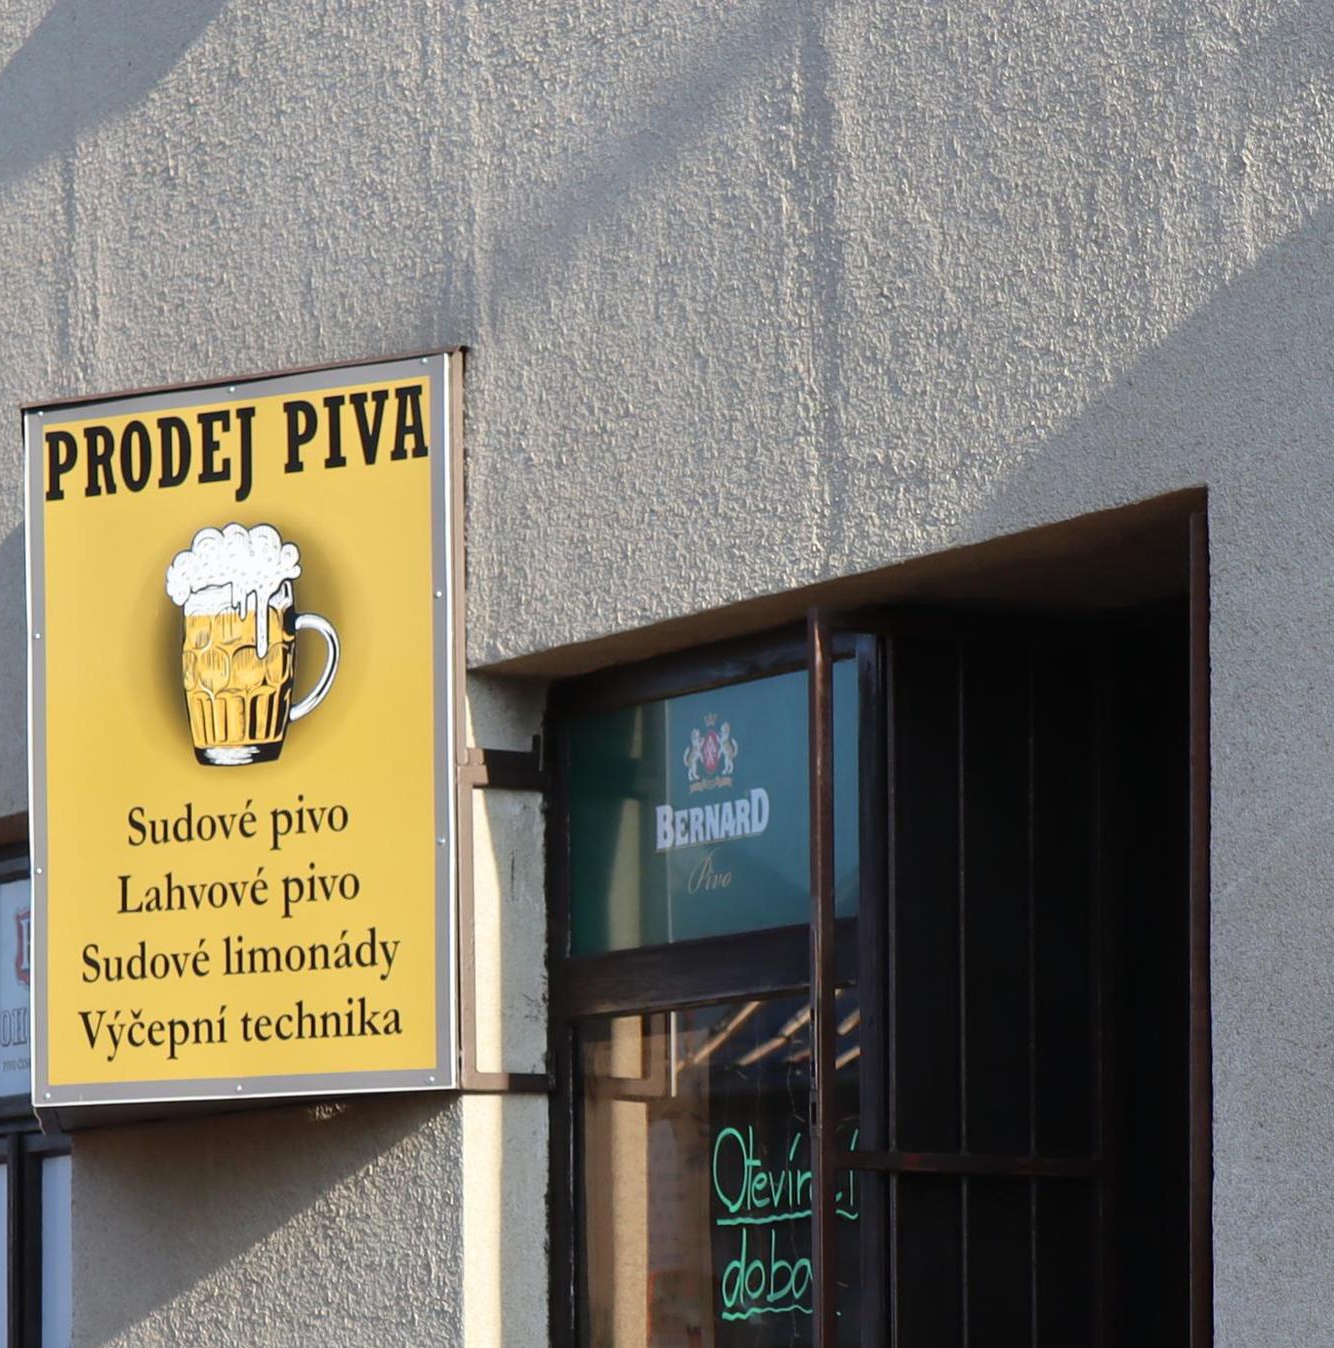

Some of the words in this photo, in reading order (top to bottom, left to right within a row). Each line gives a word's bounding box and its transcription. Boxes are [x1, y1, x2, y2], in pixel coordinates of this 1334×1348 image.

[45, 406, 256, 502] PRODEJ
[283, 385, 428, 473] PIVA
[127, 799, 257, 846] Sudové
[269, 794, 349, 851] pivo
[655, 787, 769, 850] BERNARD
[117, 866, 269, 914] Lahvové
[280, 862, 360, 919] pivo
[81, 938, 210, 983] Sudové
[222, 927, 400, 981] limonády
[78, 1005, 227, 1061] Výčepní
[240, 997, 403, 1043] technika
[712, 1124, 859, 1213] Otevírí
